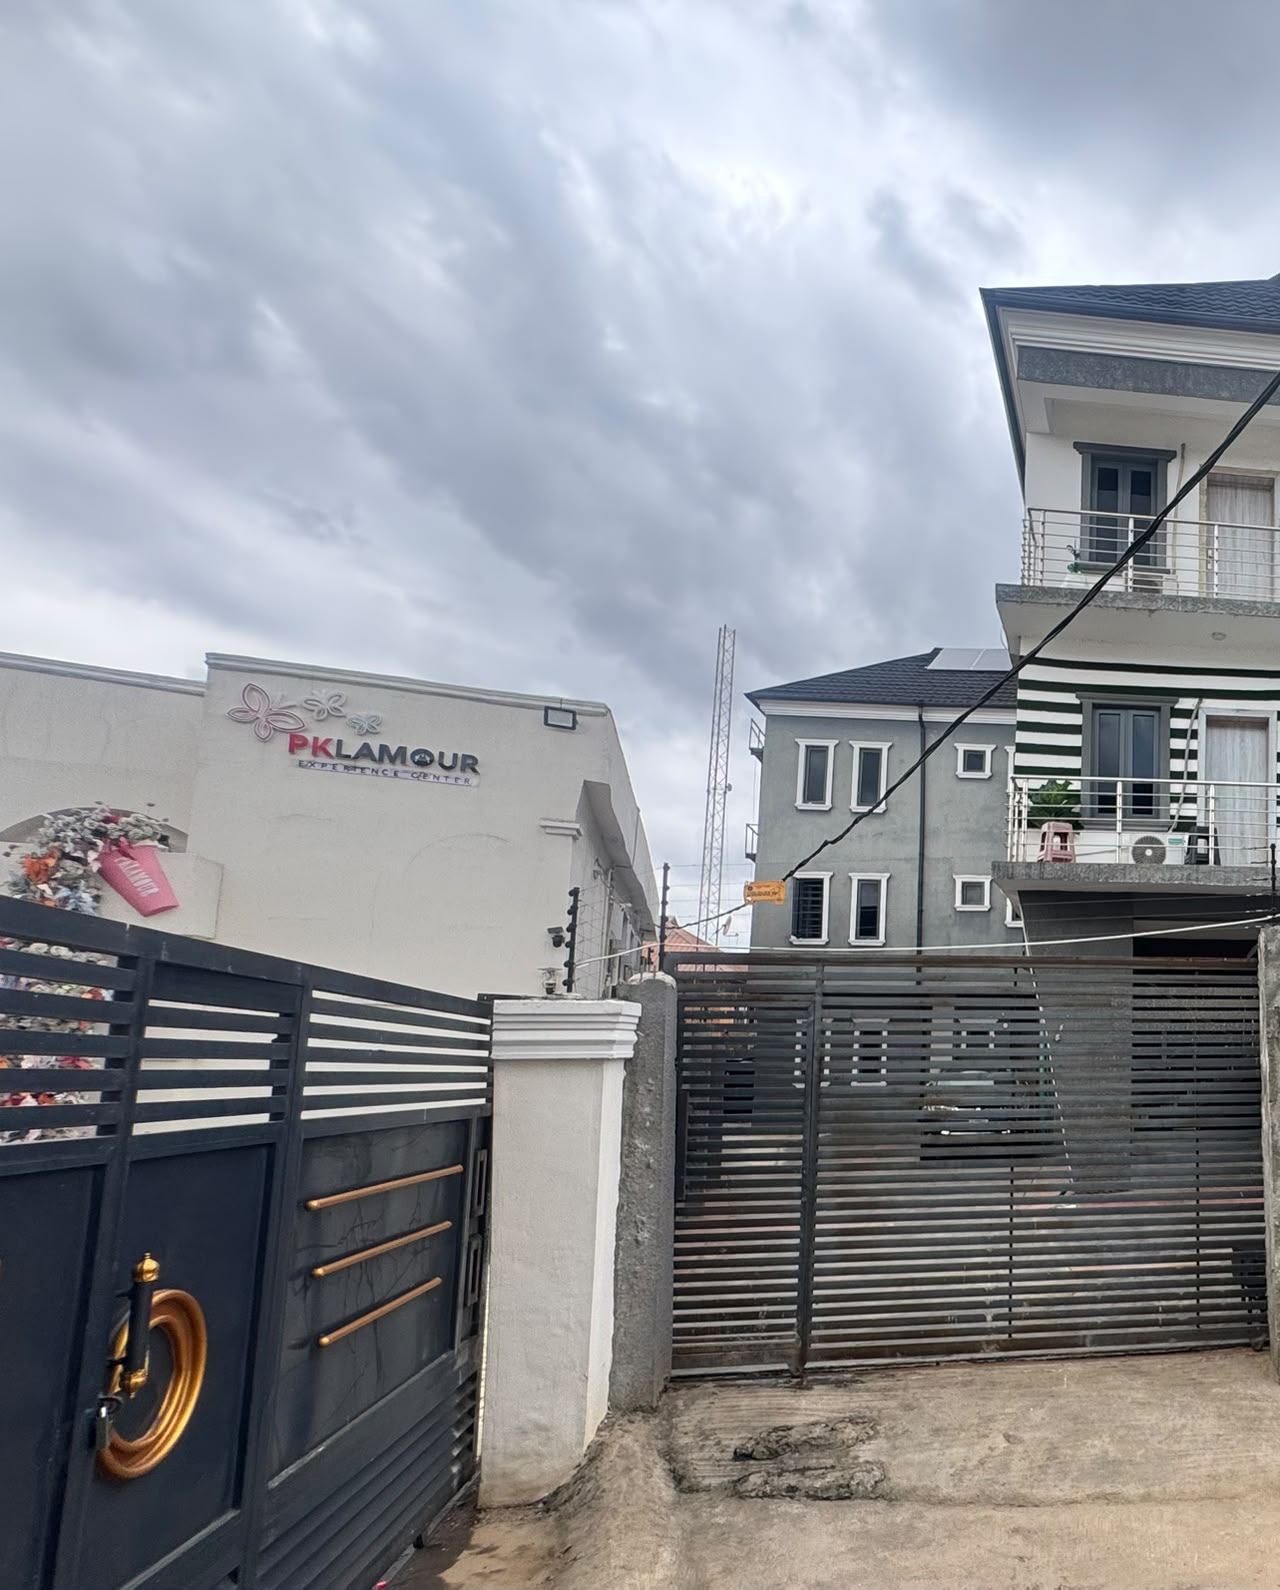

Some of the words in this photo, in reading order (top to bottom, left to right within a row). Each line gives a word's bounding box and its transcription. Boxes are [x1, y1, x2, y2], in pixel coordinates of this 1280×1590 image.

[288, 733, 480, 775] PKLAMOUR
[299, 760, 399, 777] EXPERIENCE
[411, 771, 471, 785] CENTER
